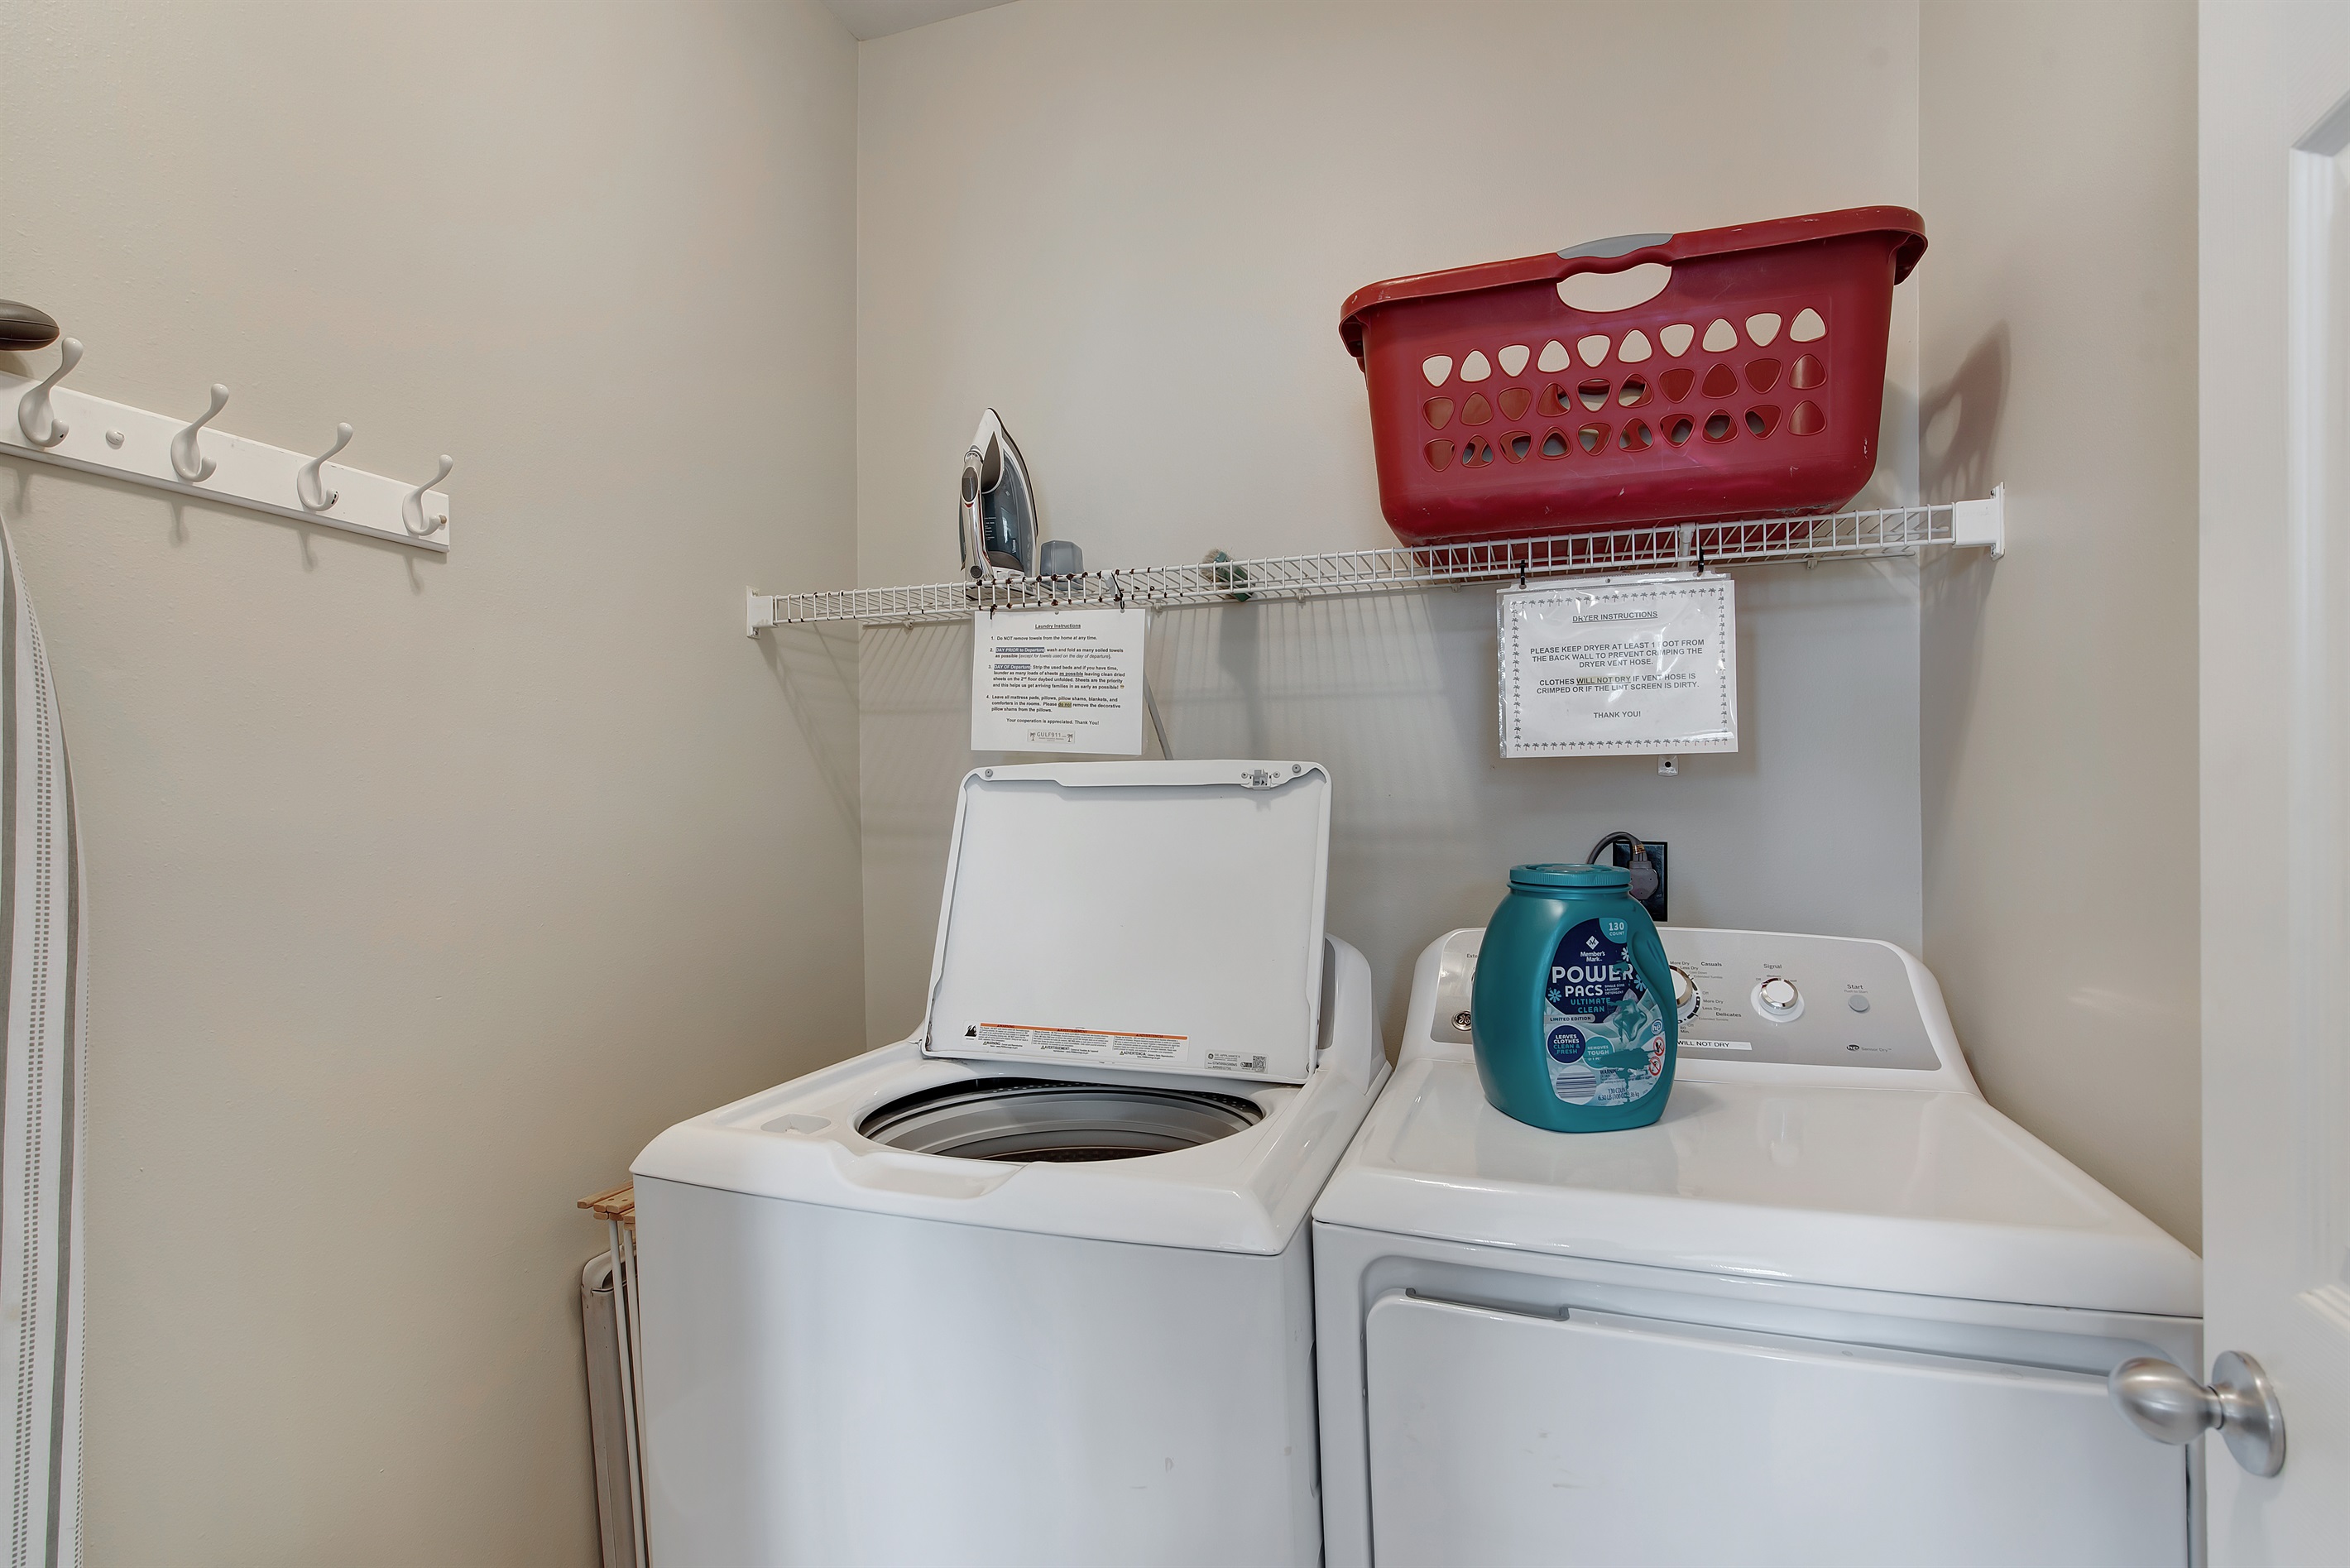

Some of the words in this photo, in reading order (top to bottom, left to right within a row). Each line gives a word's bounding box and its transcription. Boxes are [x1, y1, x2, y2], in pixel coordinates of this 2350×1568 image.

[1572, 614, 1599, 623] DRYER
[1600, 611, 1658, 621] INSTRUCTIONS
[1530, 646, 1560, 655] PLEASE
[1608, 650, 1644, 659] PREVENT
[1576, 678, 1595, 686] WILL
[1597, 676, 1613, 684] NOT
[1537, 686, 1571, 694] CRIMPED
[1609, 922, 1624, 931] 130
[1551, 963, 1633, 984] POWER
[1565, 985, 1604, 998] PACS
[1570, 997, 1611, 1005] ULTIMATE
[1577, 1005, 1605, 1014] CLEAN
